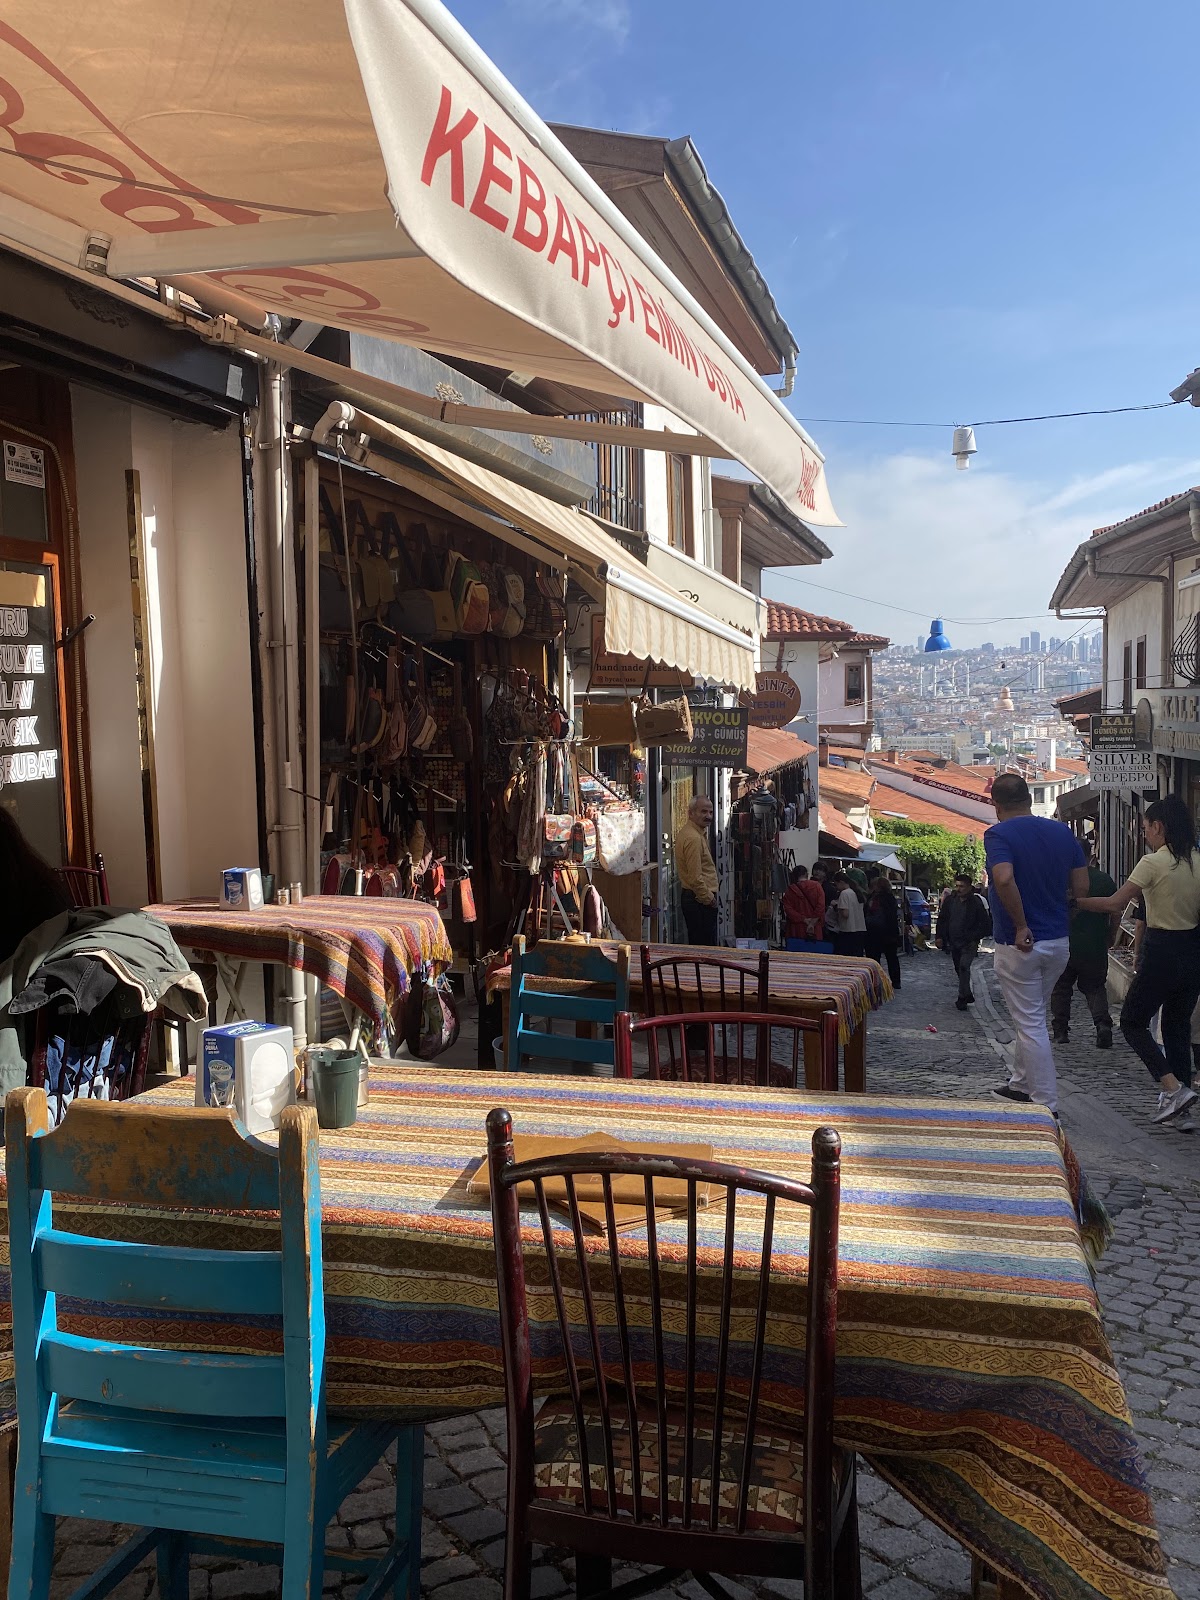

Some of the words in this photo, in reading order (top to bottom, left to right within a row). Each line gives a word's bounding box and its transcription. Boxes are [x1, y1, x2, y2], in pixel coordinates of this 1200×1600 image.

[421, 85, 634, 328] KEBAPÇI
[689, 337, 746, 421] USTA
[0, 607, 28, 638] RU
[0, 644, 45, 674] ULYE
[1161, 695, 1200, 723] KALE
[693, 728, 706, 741] AŞ
[714, 726, 745, 743] GÜMÜŞ
[665, 744, 697, 754] Stone
[709, 743, 743, 756] Silver
[1094, 752, 1152, 766] SILVER
[1093, 772, 1154, 782] СЕРЕБРО
